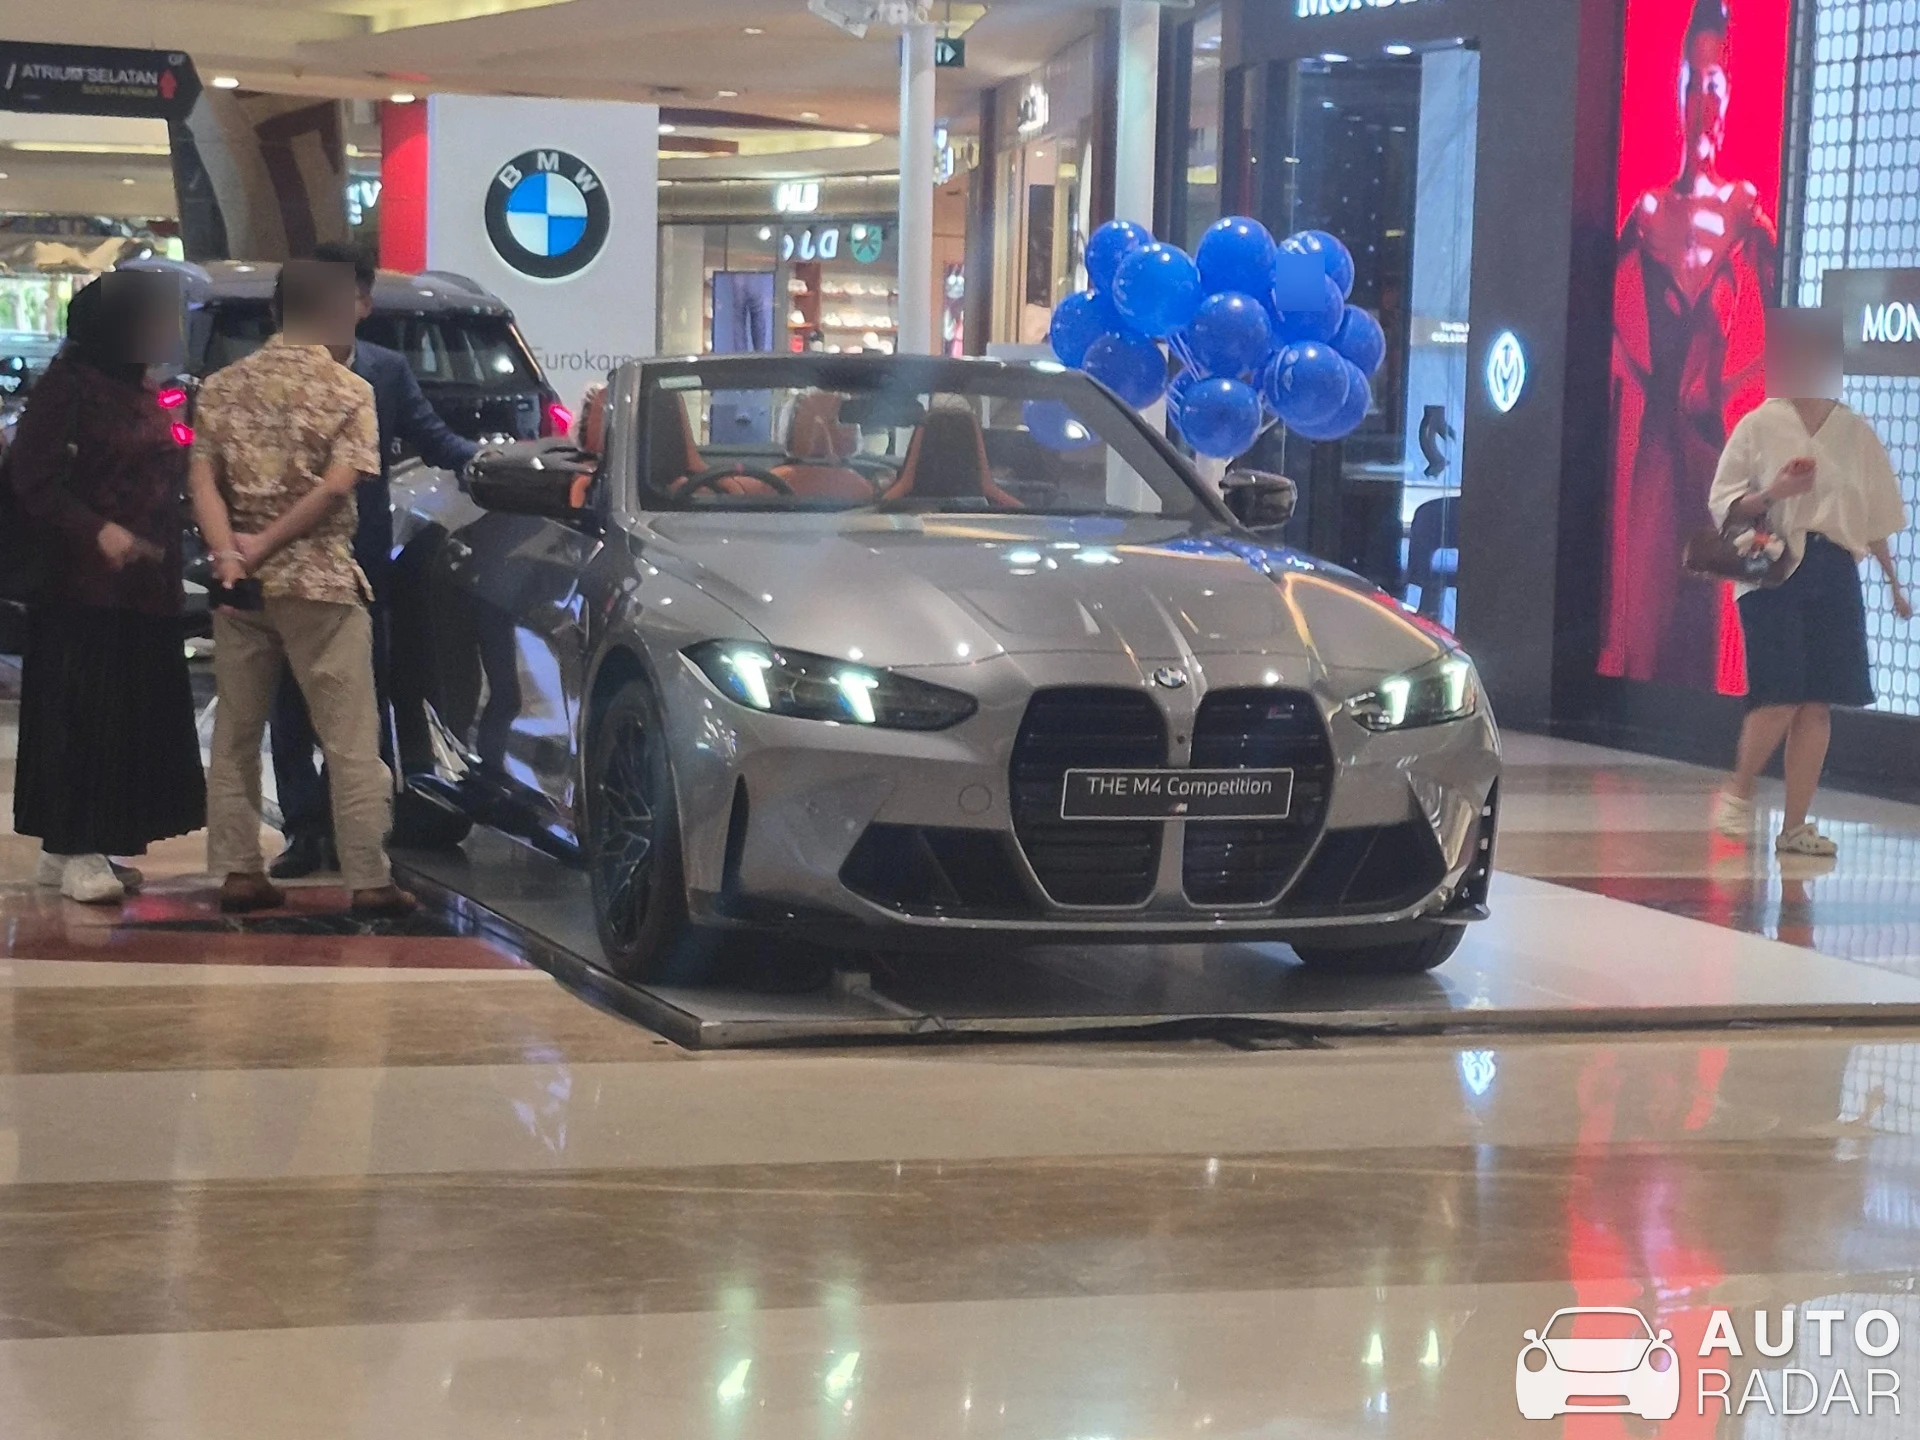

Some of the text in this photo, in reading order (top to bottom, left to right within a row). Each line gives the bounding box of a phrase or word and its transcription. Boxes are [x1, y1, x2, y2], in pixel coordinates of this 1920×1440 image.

[86, 67, 158, 85] SELATAN
[499, 151, 599, 193] BMW
[1087, 776, 1272, 798] THE M4 Competition
